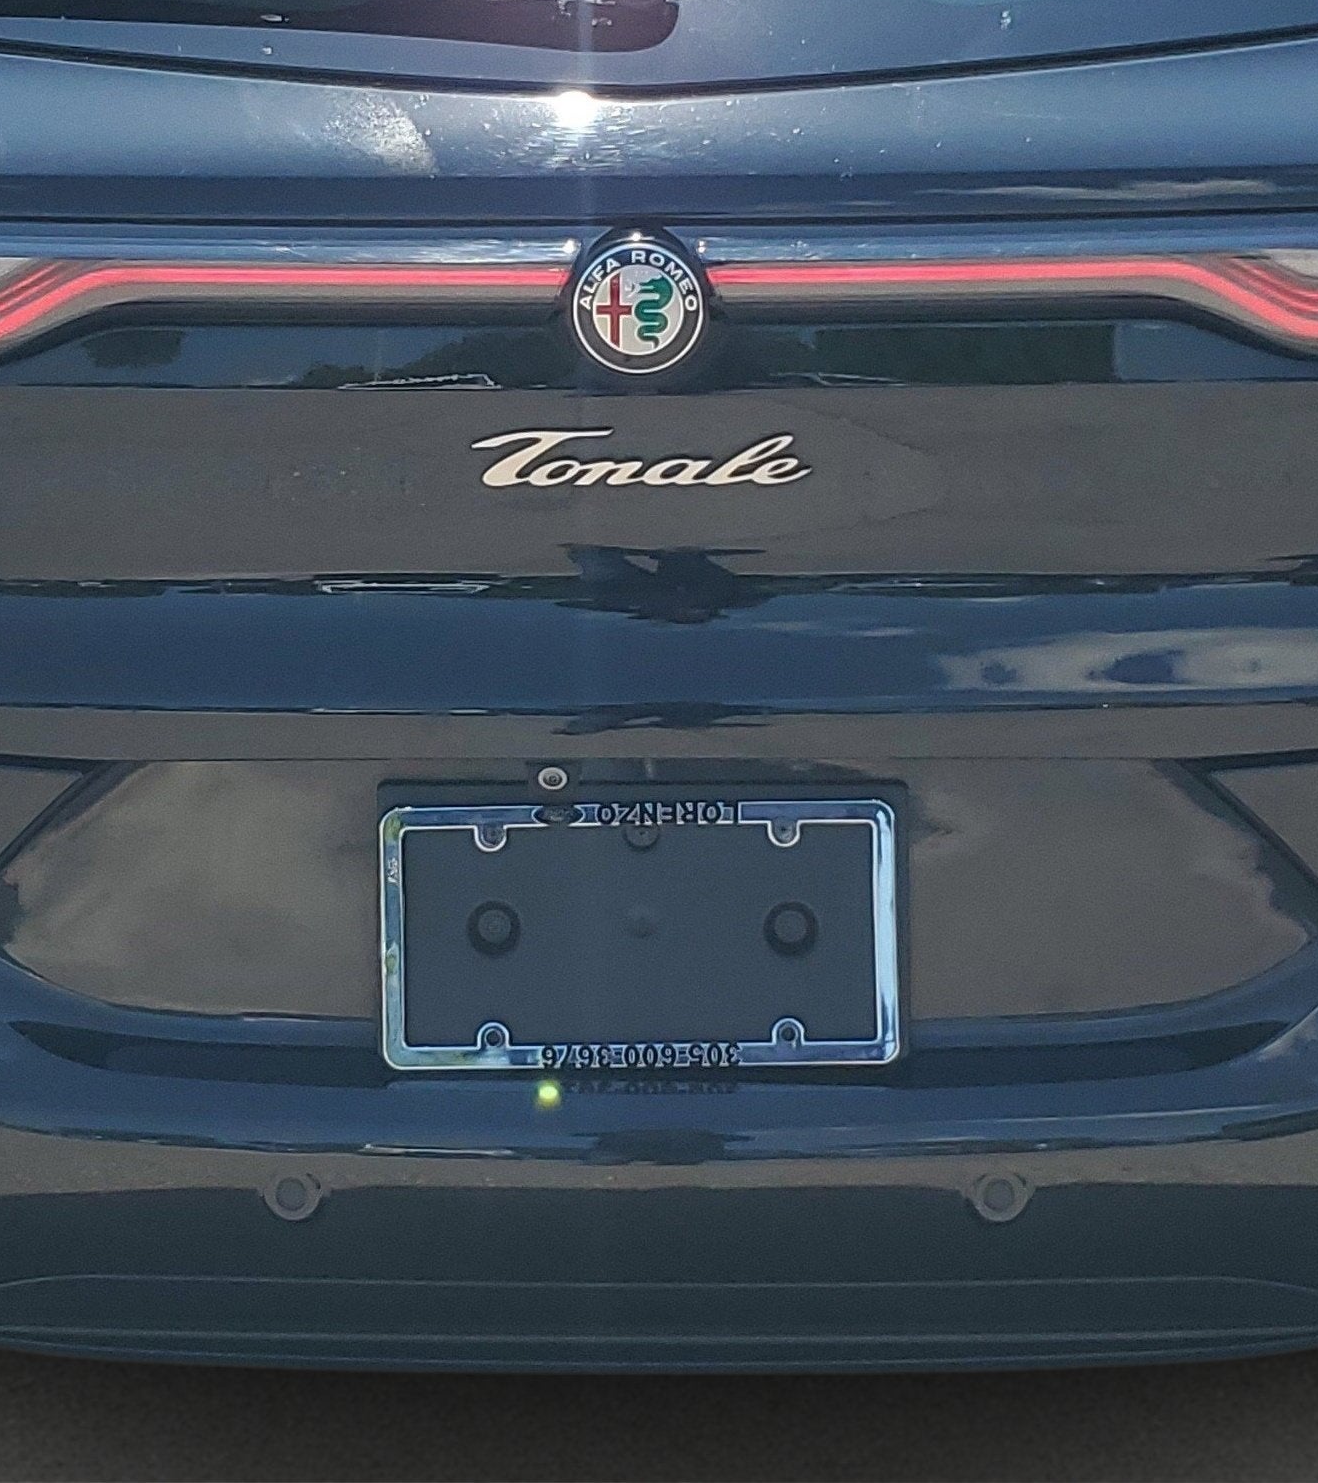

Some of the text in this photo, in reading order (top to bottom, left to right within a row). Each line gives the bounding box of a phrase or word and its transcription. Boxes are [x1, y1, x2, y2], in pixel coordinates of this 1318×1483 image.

[579, 250, 699, 312] ALFA ROMEO
[470, 427, 814, 487] Tonale
[595, 802, 737, 826] LORENZO
